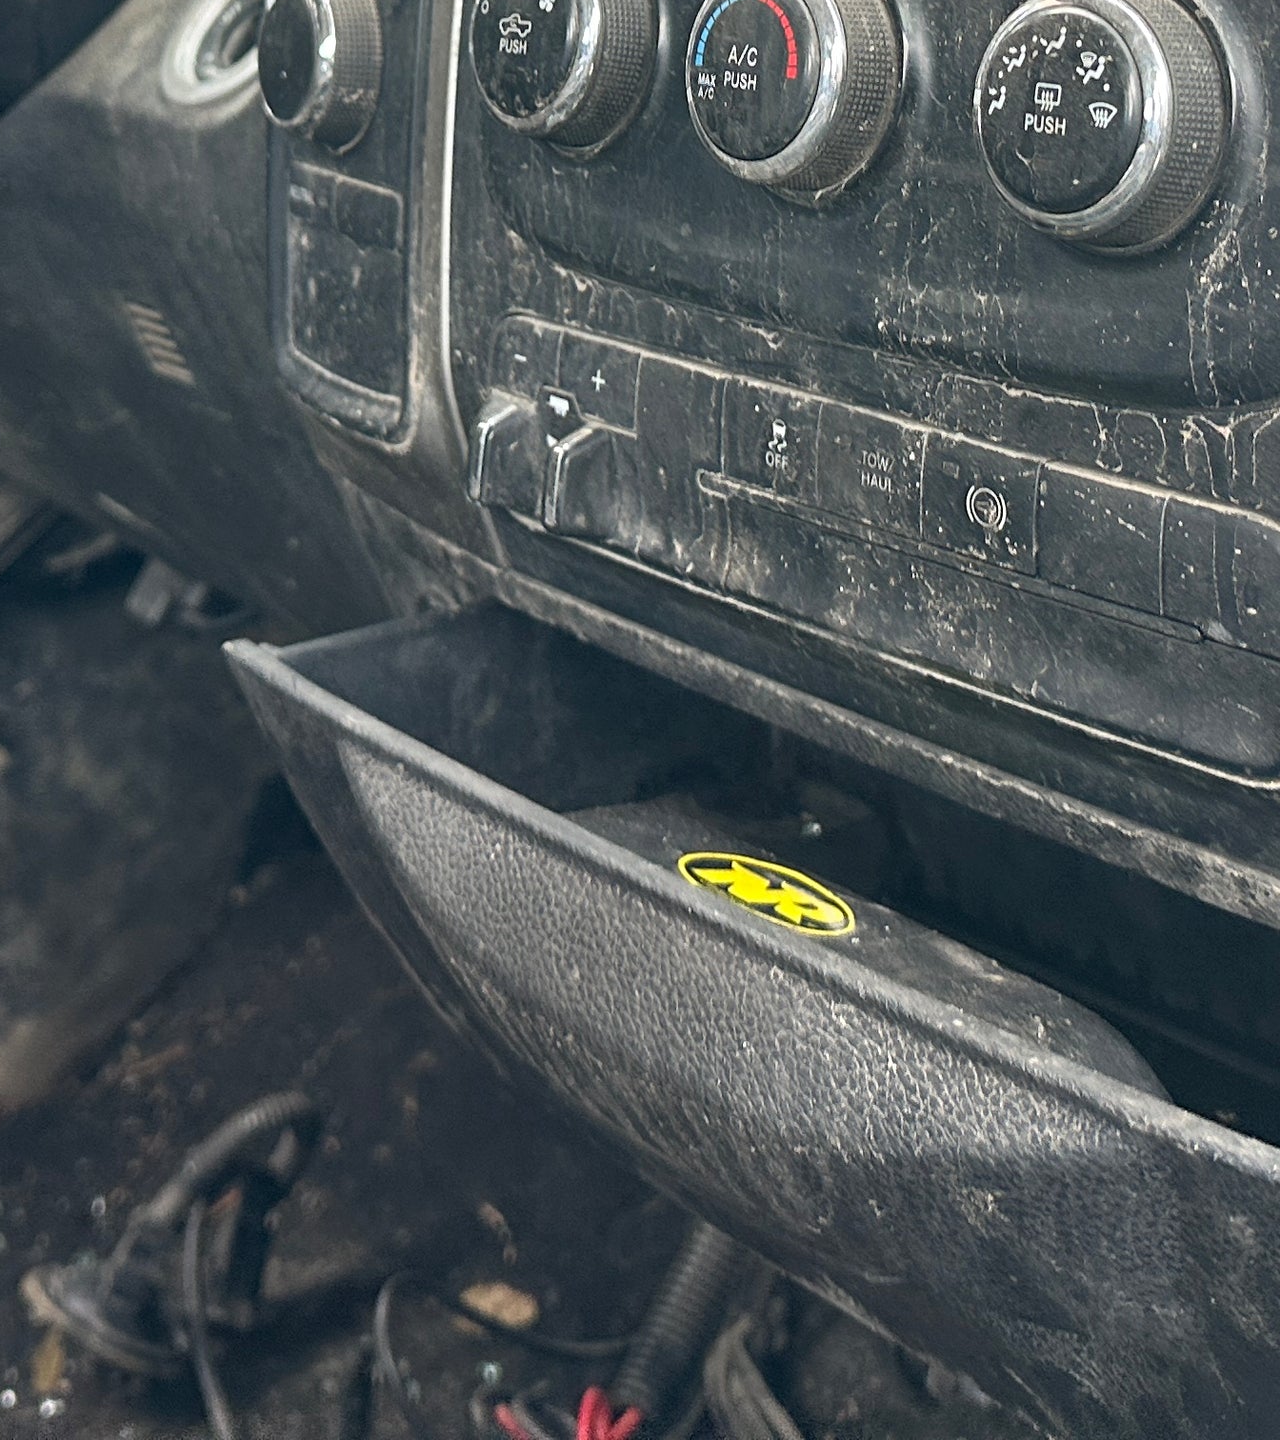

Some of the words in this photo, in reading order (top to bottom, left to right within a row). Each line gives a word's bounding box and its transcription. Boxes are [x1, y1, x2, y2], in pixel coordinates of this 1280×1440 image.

[499, 37, 527, 55] PUSH
[727, 44, 758, 67] A/C
[698, 72, 716, 87] MAX
[723, 70, 757, 91] PUSH
[698, 86, 714, 100] A/C
[1024, 112, 1066, 136] PUSH
[765, 450, 788, 472] OFF
[861, 471, 893, 493] HAUL
